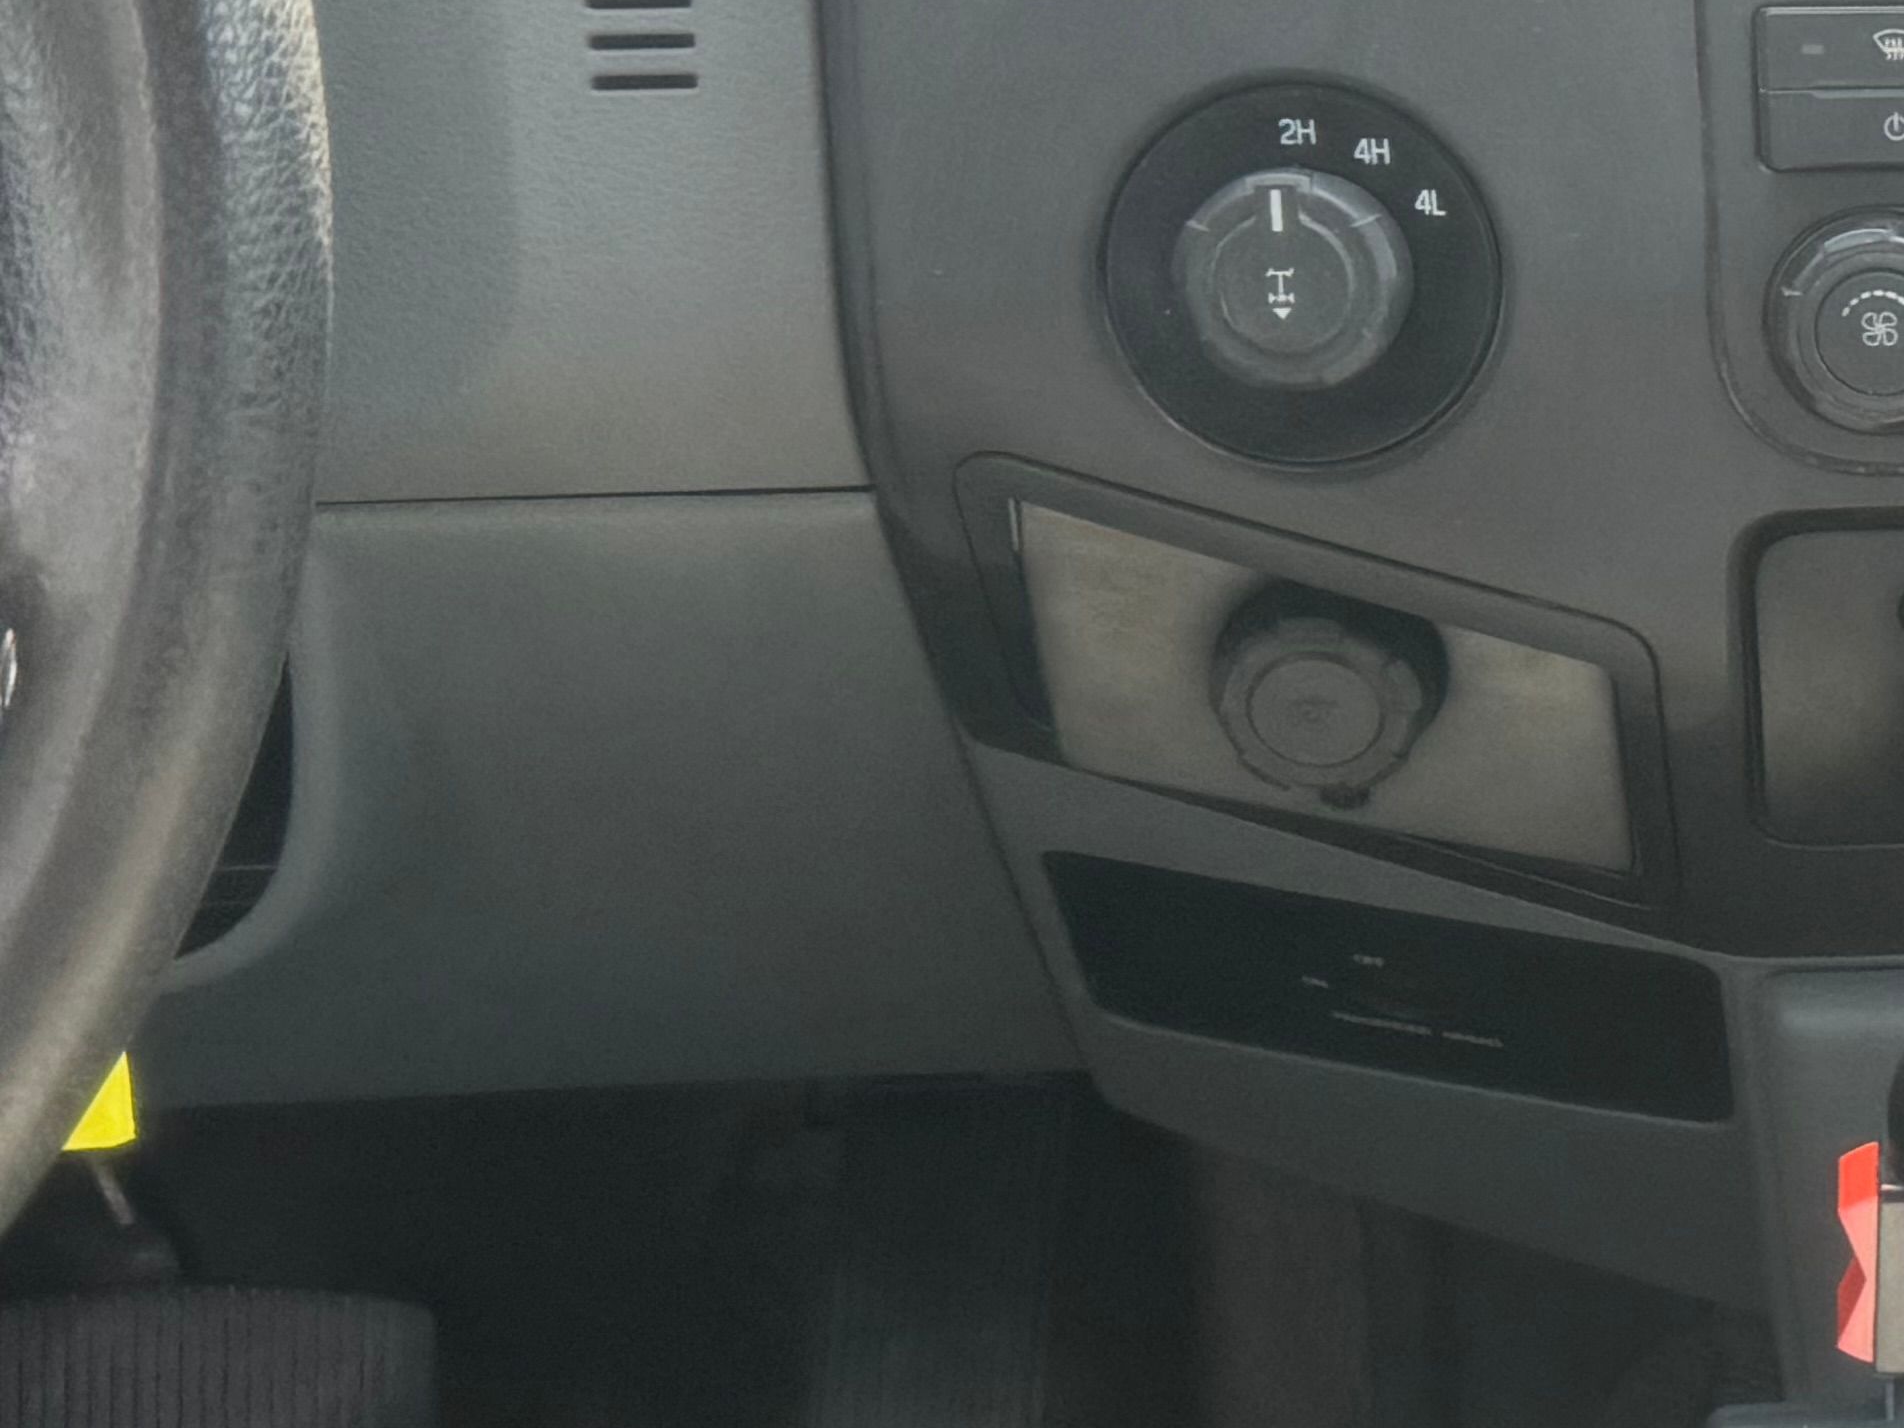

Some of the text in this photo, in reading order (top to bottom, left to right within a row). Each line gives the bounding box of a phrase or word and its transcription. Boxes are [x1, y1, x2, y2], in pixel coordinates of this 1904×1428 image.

[1278, 118, 1317, 146] 2H
[1353, 138, 1391, 165] 4H
[1414, 189, 1448, 217] 4L
